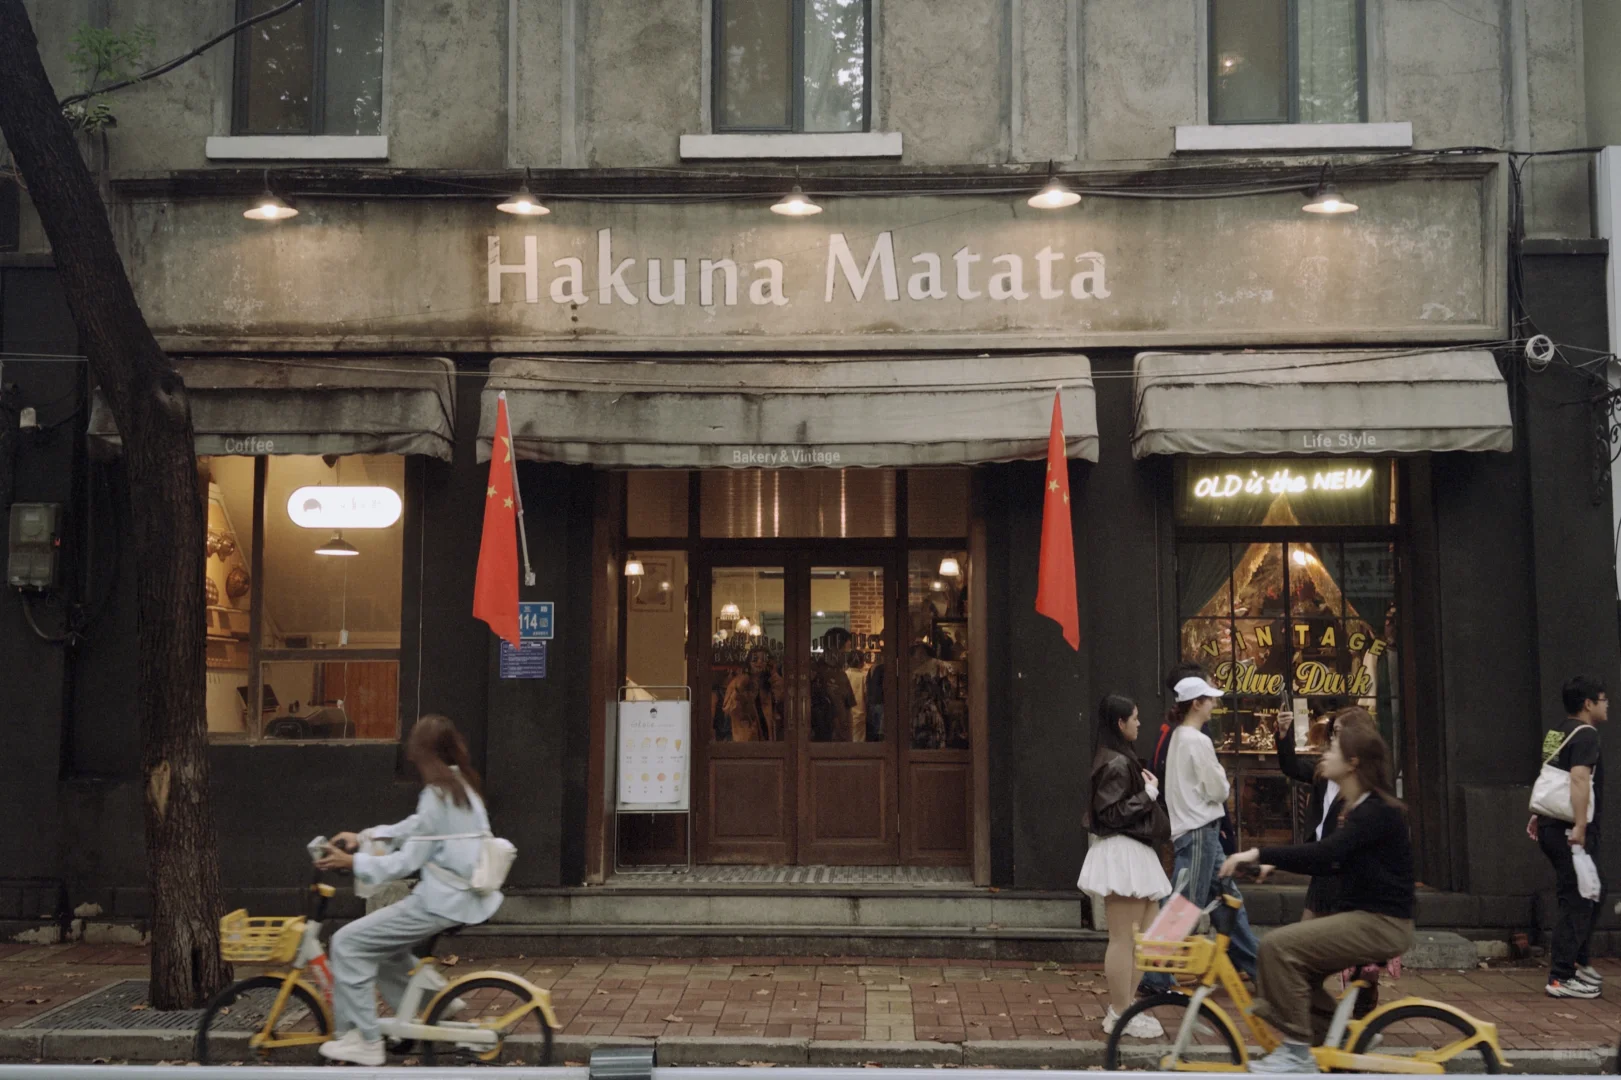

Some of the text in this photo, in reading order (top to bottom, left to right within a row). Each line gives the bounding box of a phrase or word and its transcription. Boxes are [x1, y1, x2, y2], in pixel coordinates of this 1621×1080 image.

[487, 227, 1112, 305] Hakuna Matata
[225, 436, 274, 453] Coffee
[1303, 431, 1377, 449] Life Style
[733, 449, 840, 465] Bakery & Vintage
[1194, 467, 1373, 498] OLD is the NEW
[1202, 624, 1387, 657] VINTAGE
[1216, 661, 1285, 695] Blue
